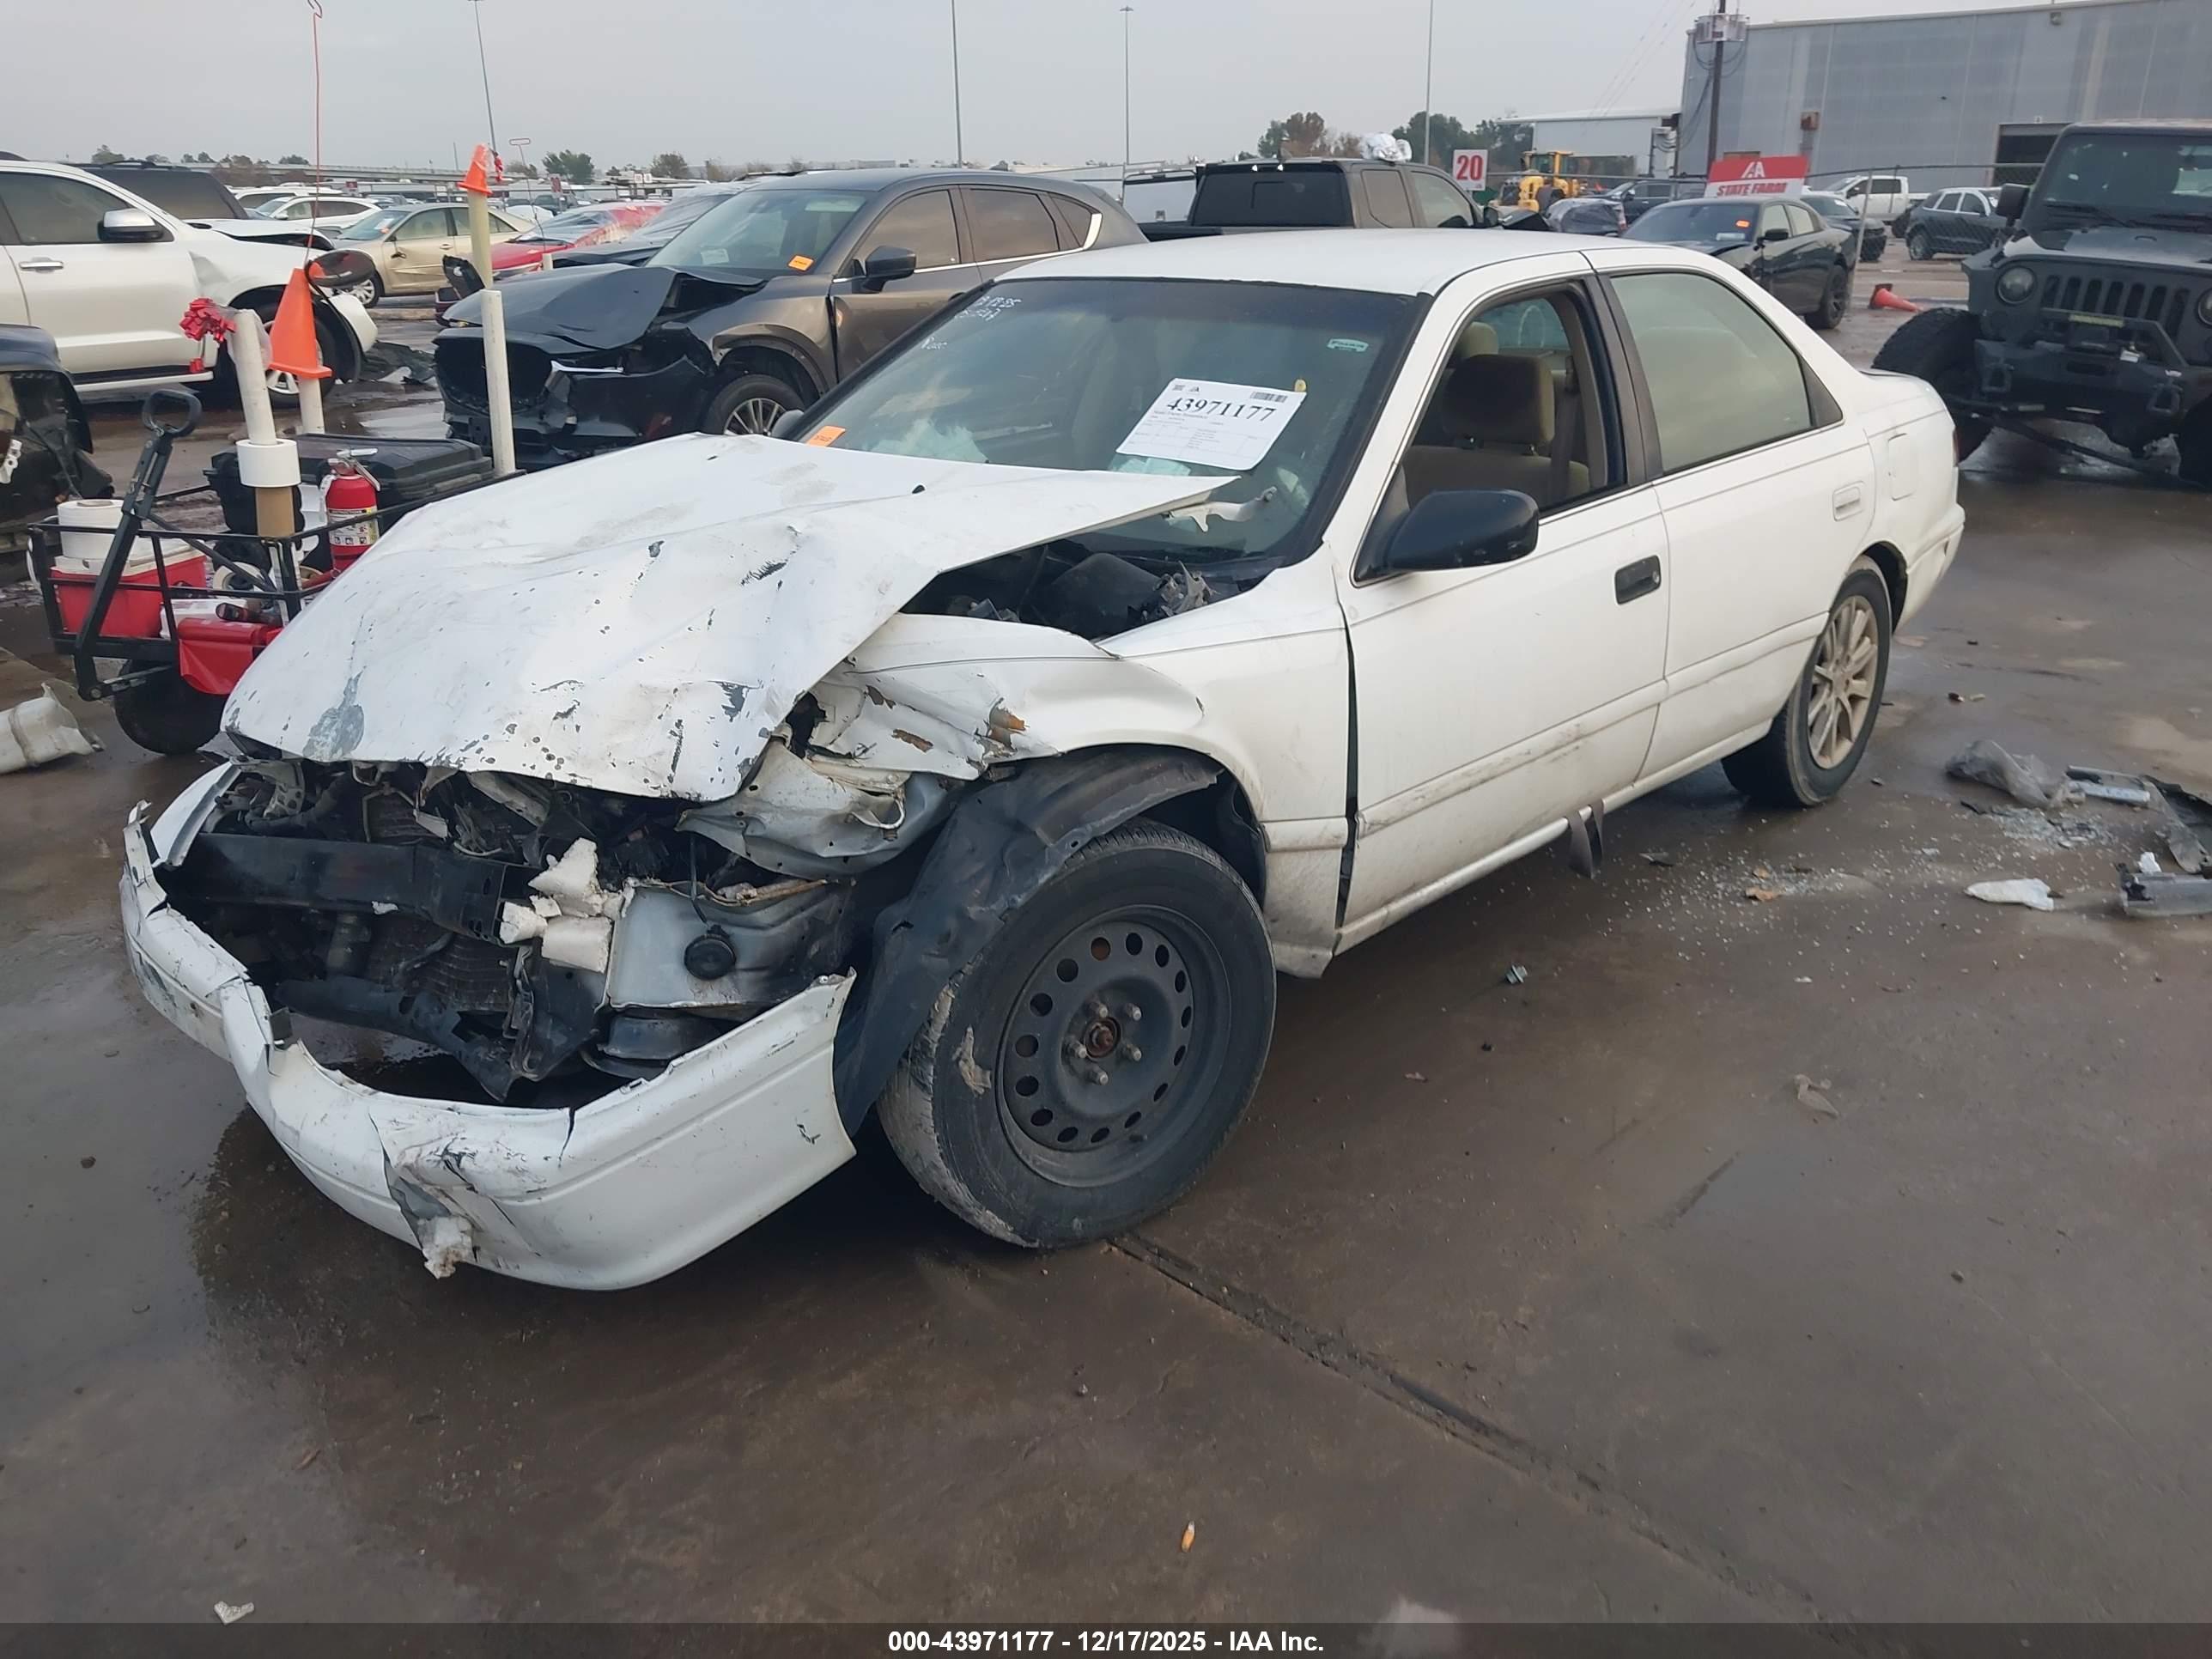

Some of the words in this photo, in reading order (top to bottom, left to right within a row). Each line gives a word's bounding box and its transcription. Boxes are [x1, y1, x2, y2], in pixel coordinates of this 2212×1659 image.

[1456, 155, 1483, 180] 20
[1717, 183, 1750, 197] STATE
[1166, 397, 1277, 422] 43971177
